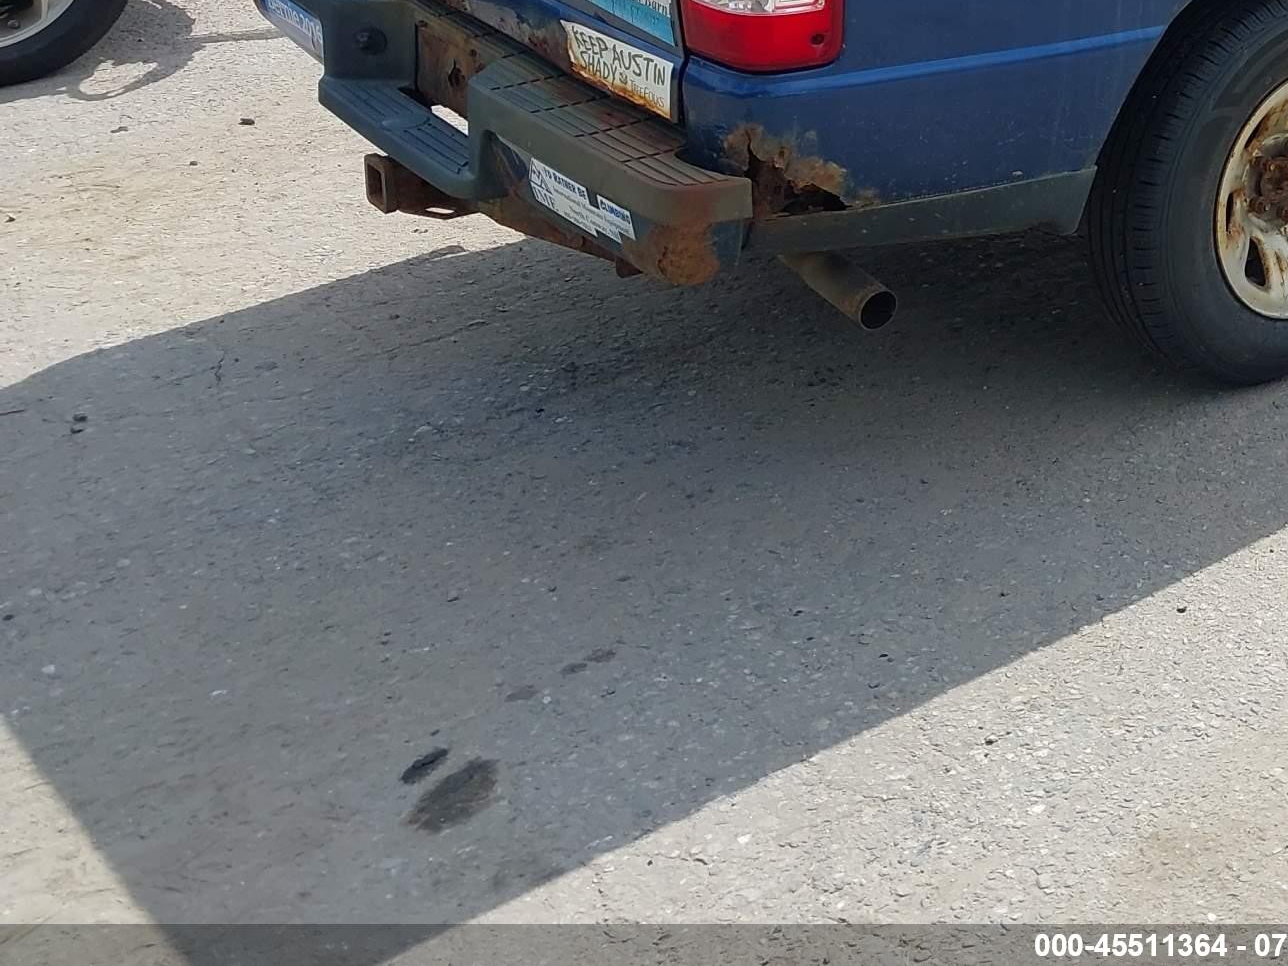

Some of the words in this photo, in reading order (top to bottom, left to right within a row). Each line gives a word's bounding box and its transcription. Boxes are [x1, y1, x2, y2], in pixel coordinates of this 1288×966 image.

[571, 25, 608, 58] KEEP
[613, 44, 666, 86] AUSTIN
[580, 51, 617, 86] SHADY
